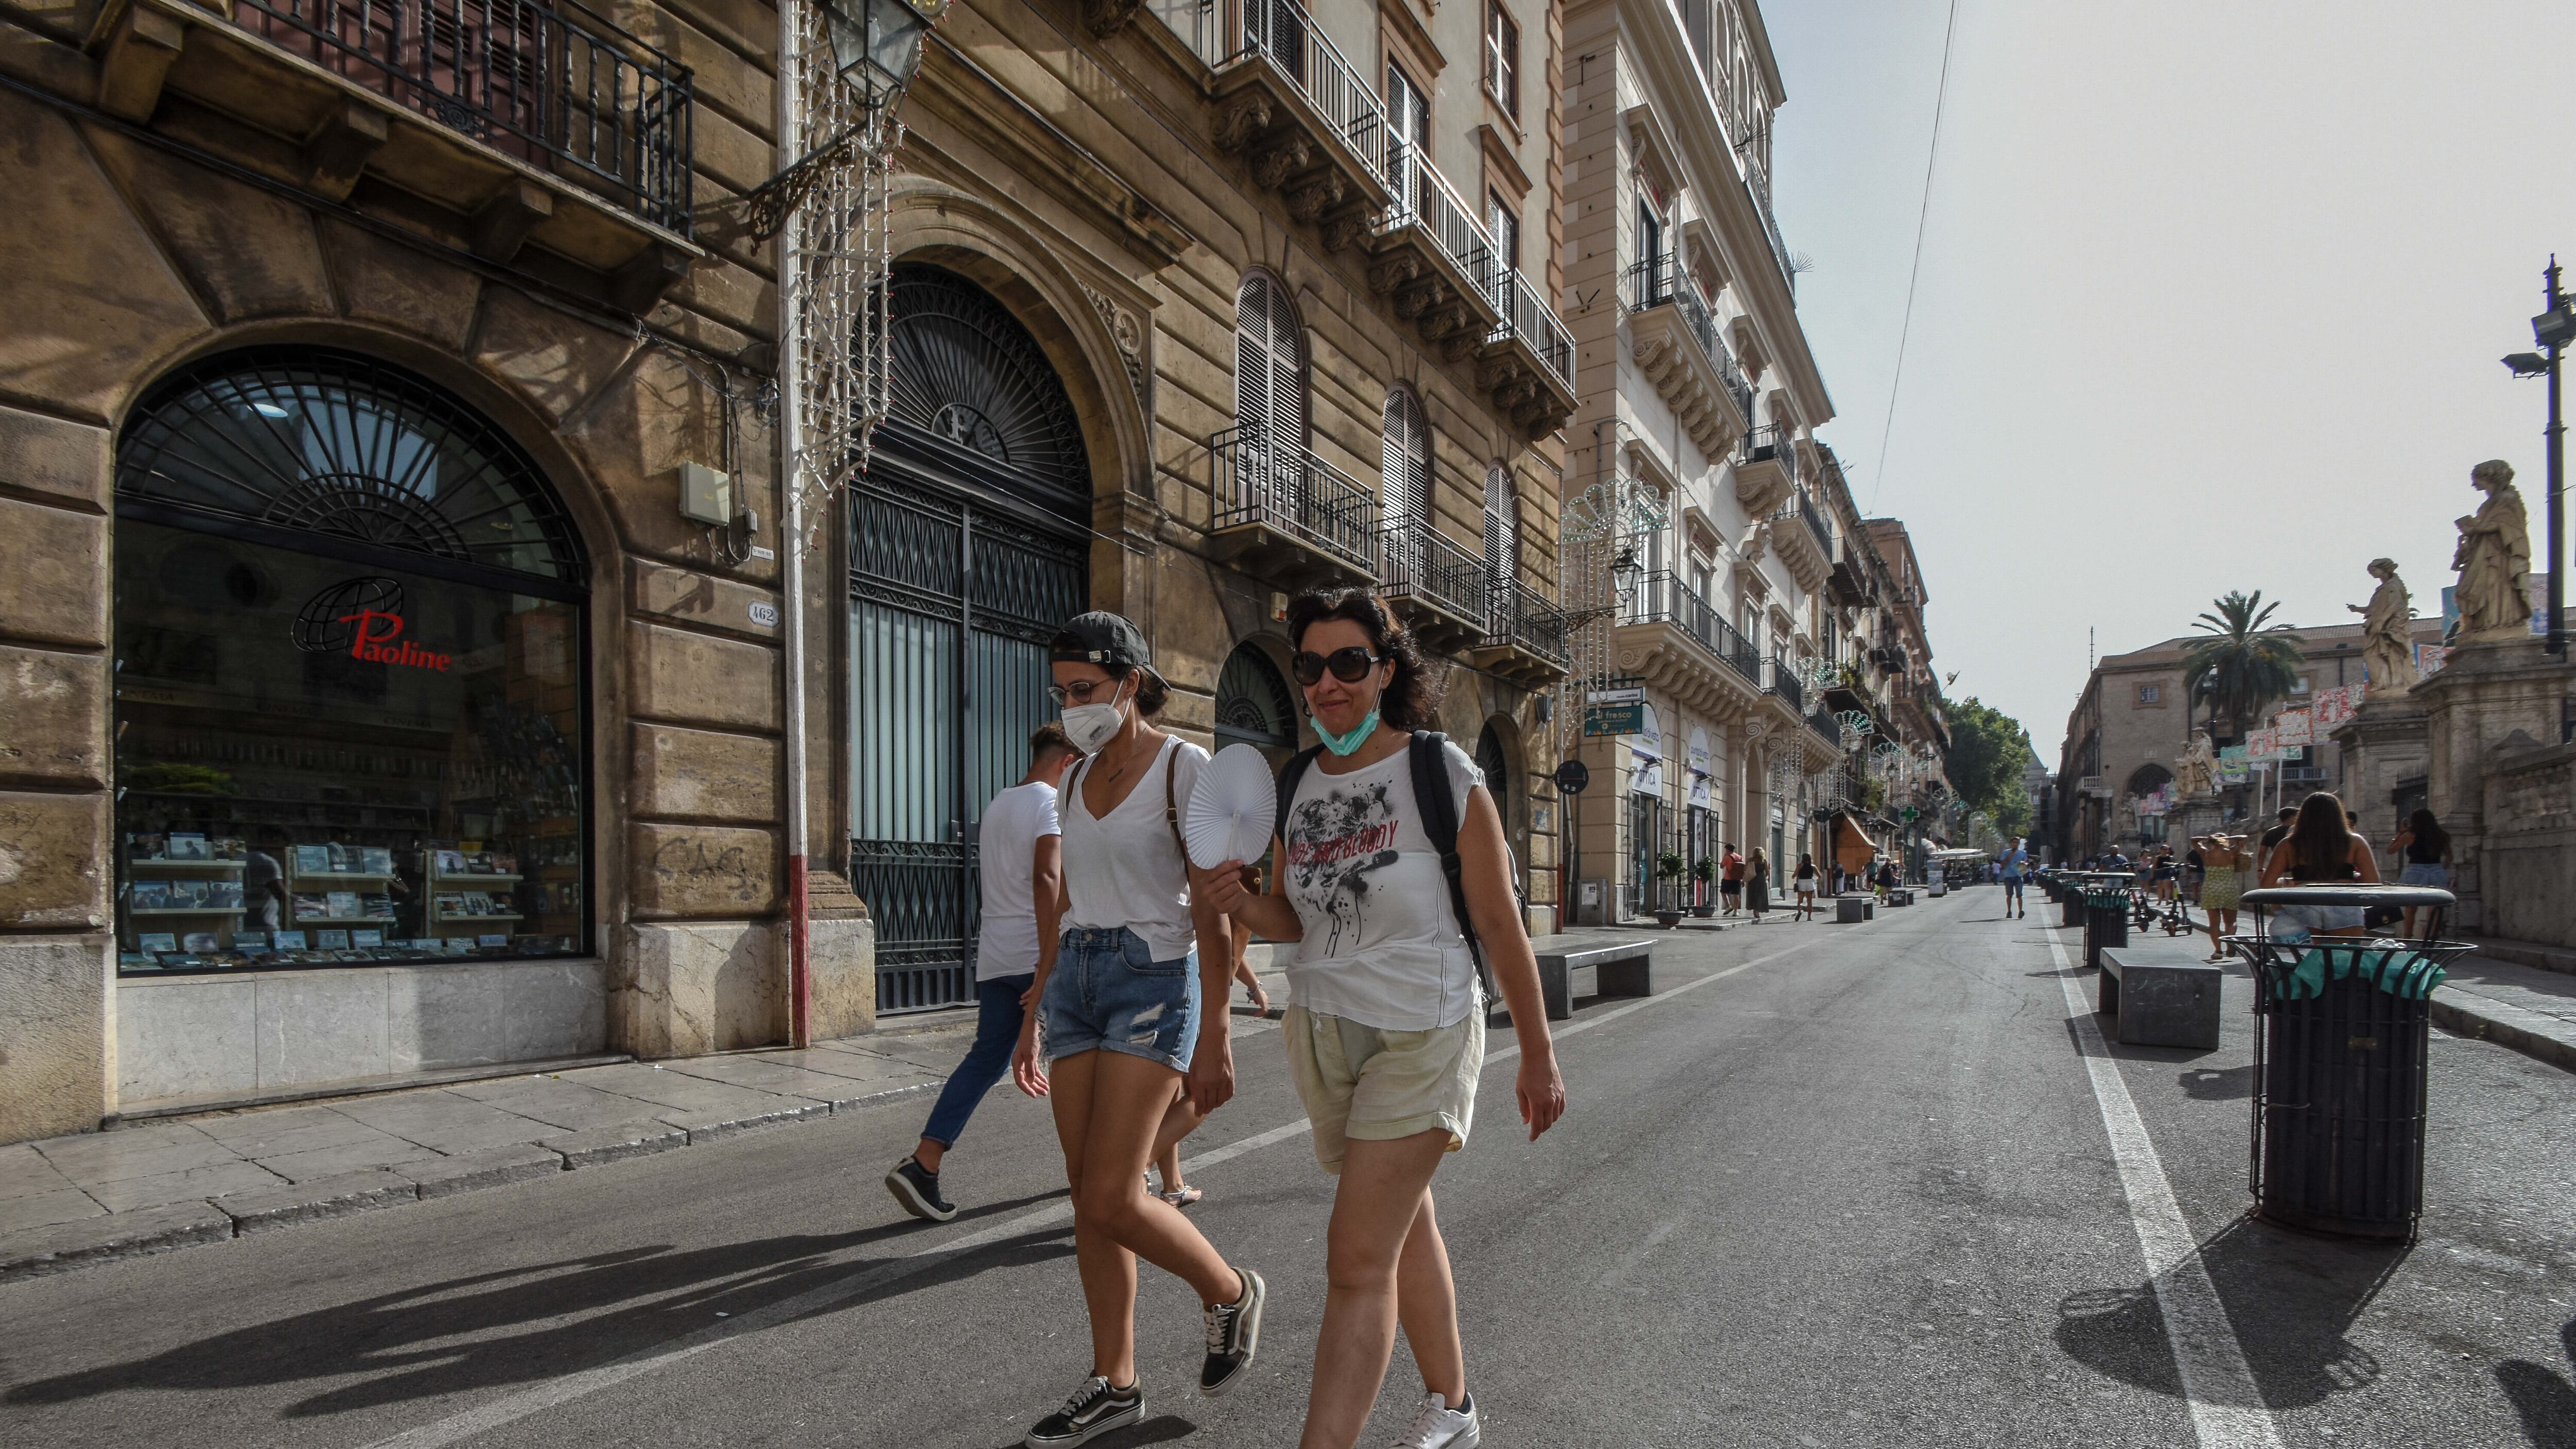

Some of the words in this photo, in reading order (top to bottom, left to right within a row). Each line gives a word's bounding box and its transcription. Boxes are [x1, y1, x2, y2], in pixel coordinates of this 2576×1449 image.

[753, 605, 774, 622] 462
[340, 608, 452, 672] Paoline
[1605, 710, 1632, 719] fresco
[1639, 769, 1656, 787] OTTICA
[1343, 820, 1399, 860] BLOODY
